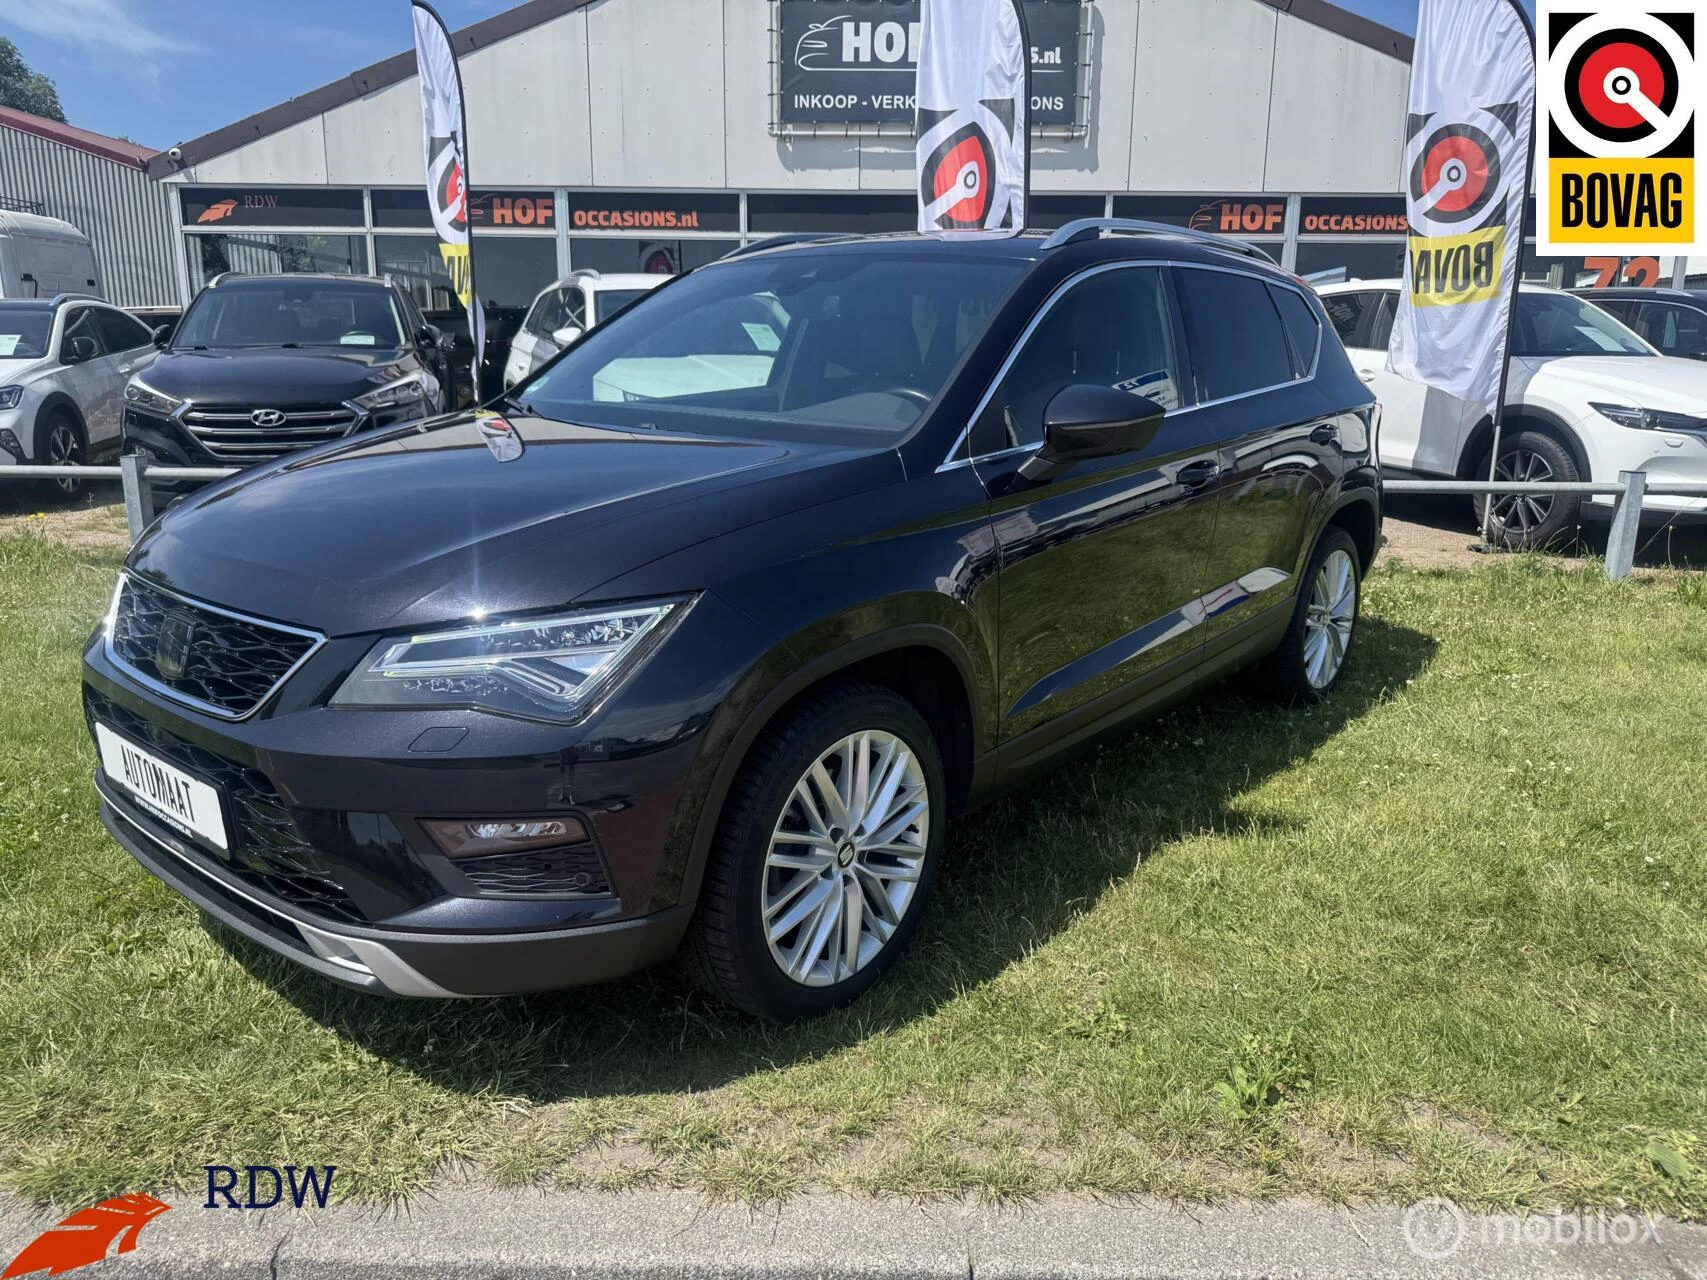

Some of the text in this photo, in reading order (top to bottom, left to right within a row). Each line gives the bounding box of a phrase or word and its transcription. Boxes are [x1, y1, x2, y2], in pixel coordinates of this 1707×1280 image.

[794, 94, 858, 109] INKOOP
[871, 95, 917, 109] VERK
[1031, 96, 1064, 111] ONS
[244, 195, 278, 208] RDW
[492, 198, 699, 228] HOF OCCASIONS.nl
[1220, 204, 1409, 231] HOF OCCASIONS
[121, 744, 195, 823] AUTOMAAT
